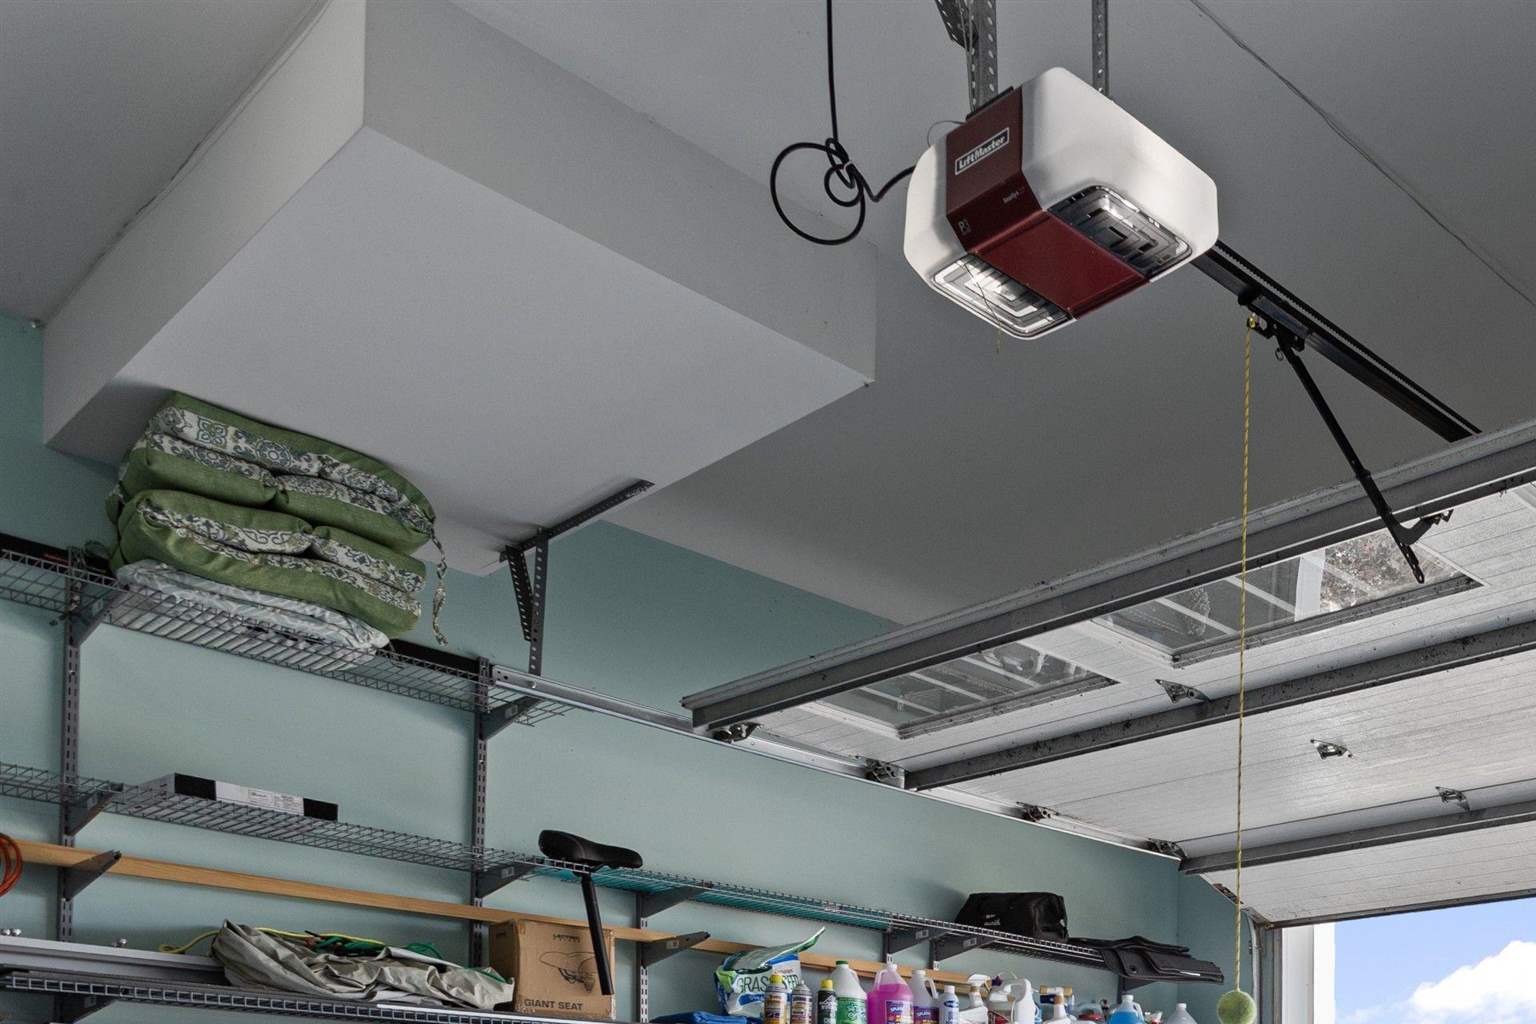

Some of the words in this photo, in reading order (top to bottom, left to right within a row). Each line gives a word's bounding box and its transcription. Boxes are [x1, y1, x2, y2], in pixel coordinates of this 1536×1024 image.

[958, 135, 1006, 170] LiftMaster
[736, 975, 770, 994] GRAS
[524, 999, 556, 1009] GIANT
[558, 1001, 584, 1011] SEAT
